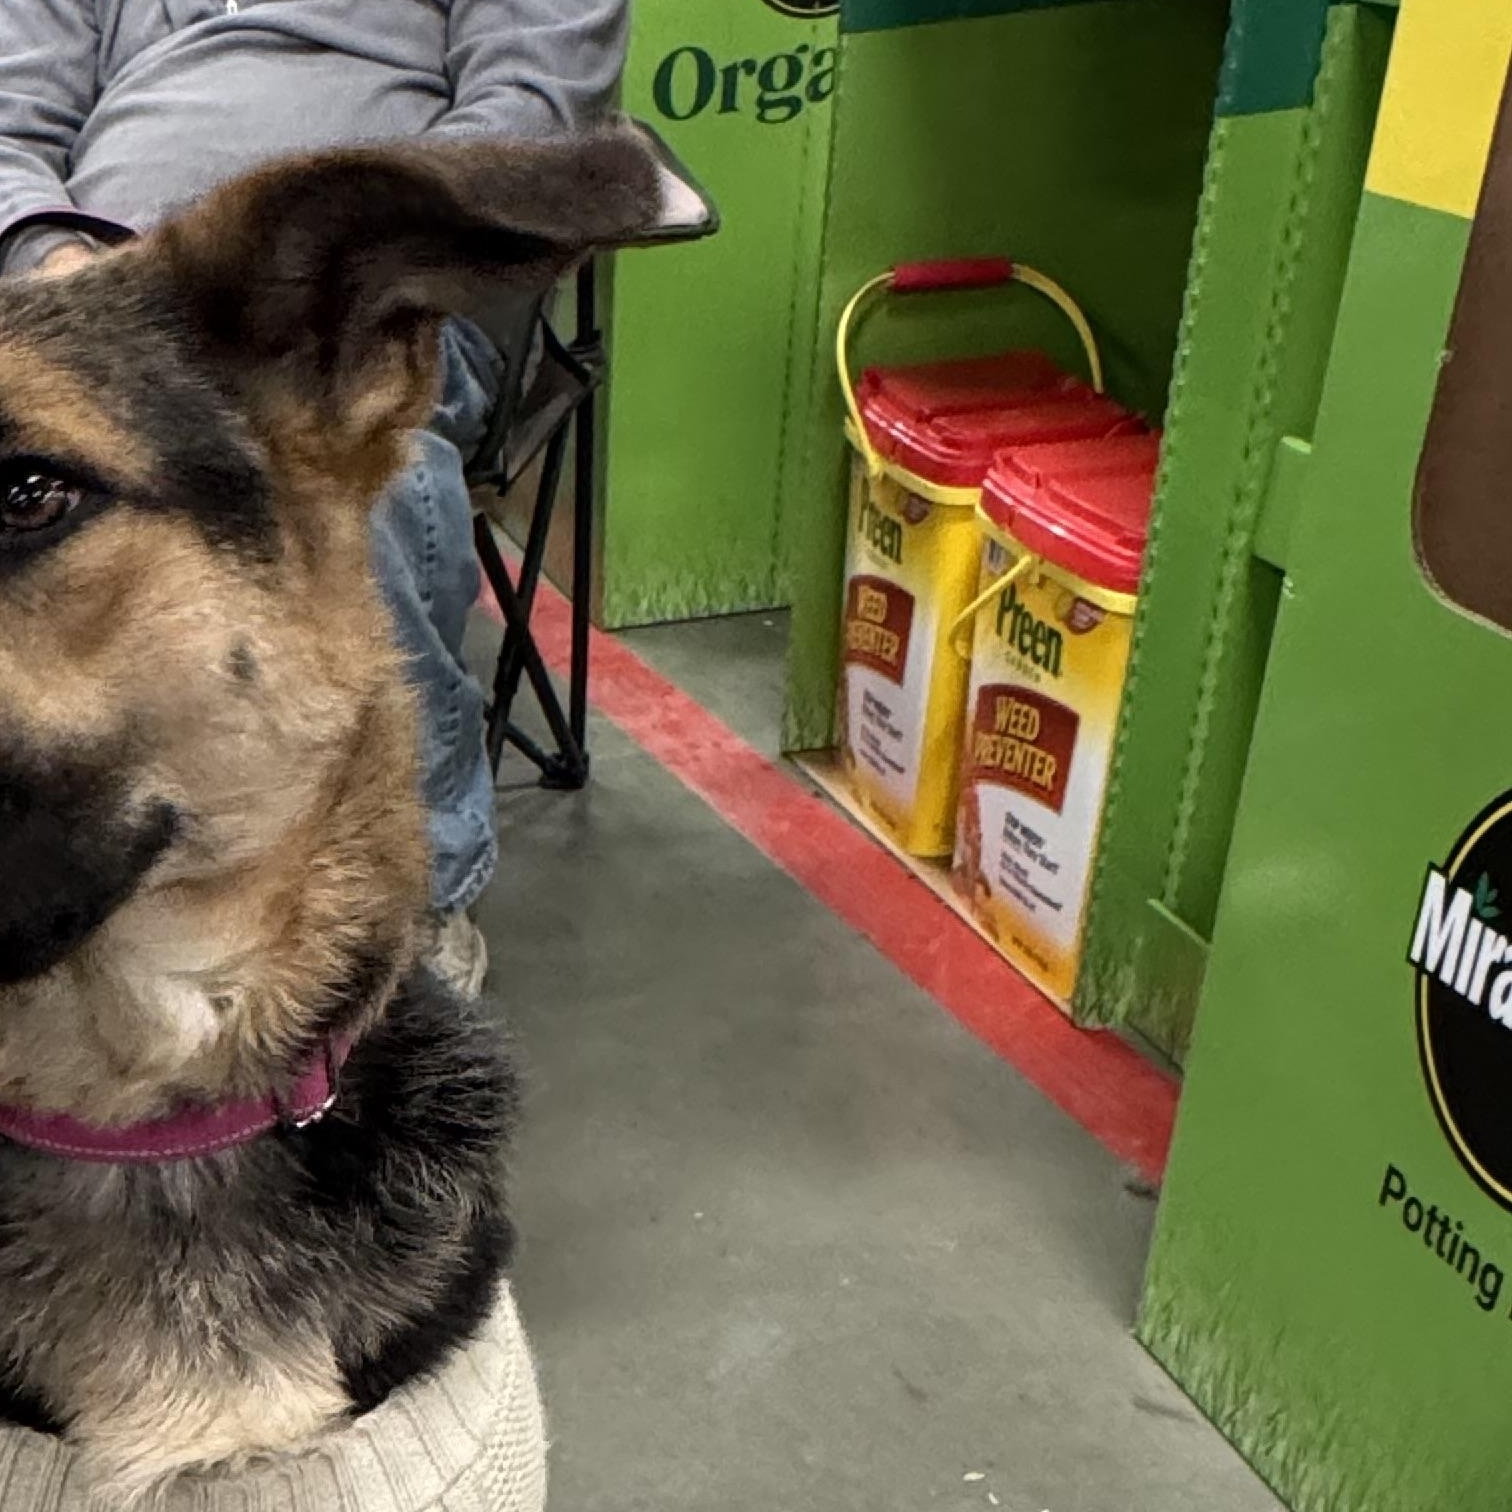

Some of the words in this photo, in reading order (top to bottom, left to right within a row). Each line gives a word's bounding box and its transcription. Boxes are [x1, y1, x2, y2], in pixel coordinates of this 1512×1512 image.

[653, 44, 836, 124] Orga
[996, 581, 1063, 678] Preen
[995, 696, 1040, 741] WEED
[1410, 869, 1512, 1030] Mira
[1379, 1163, 1504, 1312] Potting
